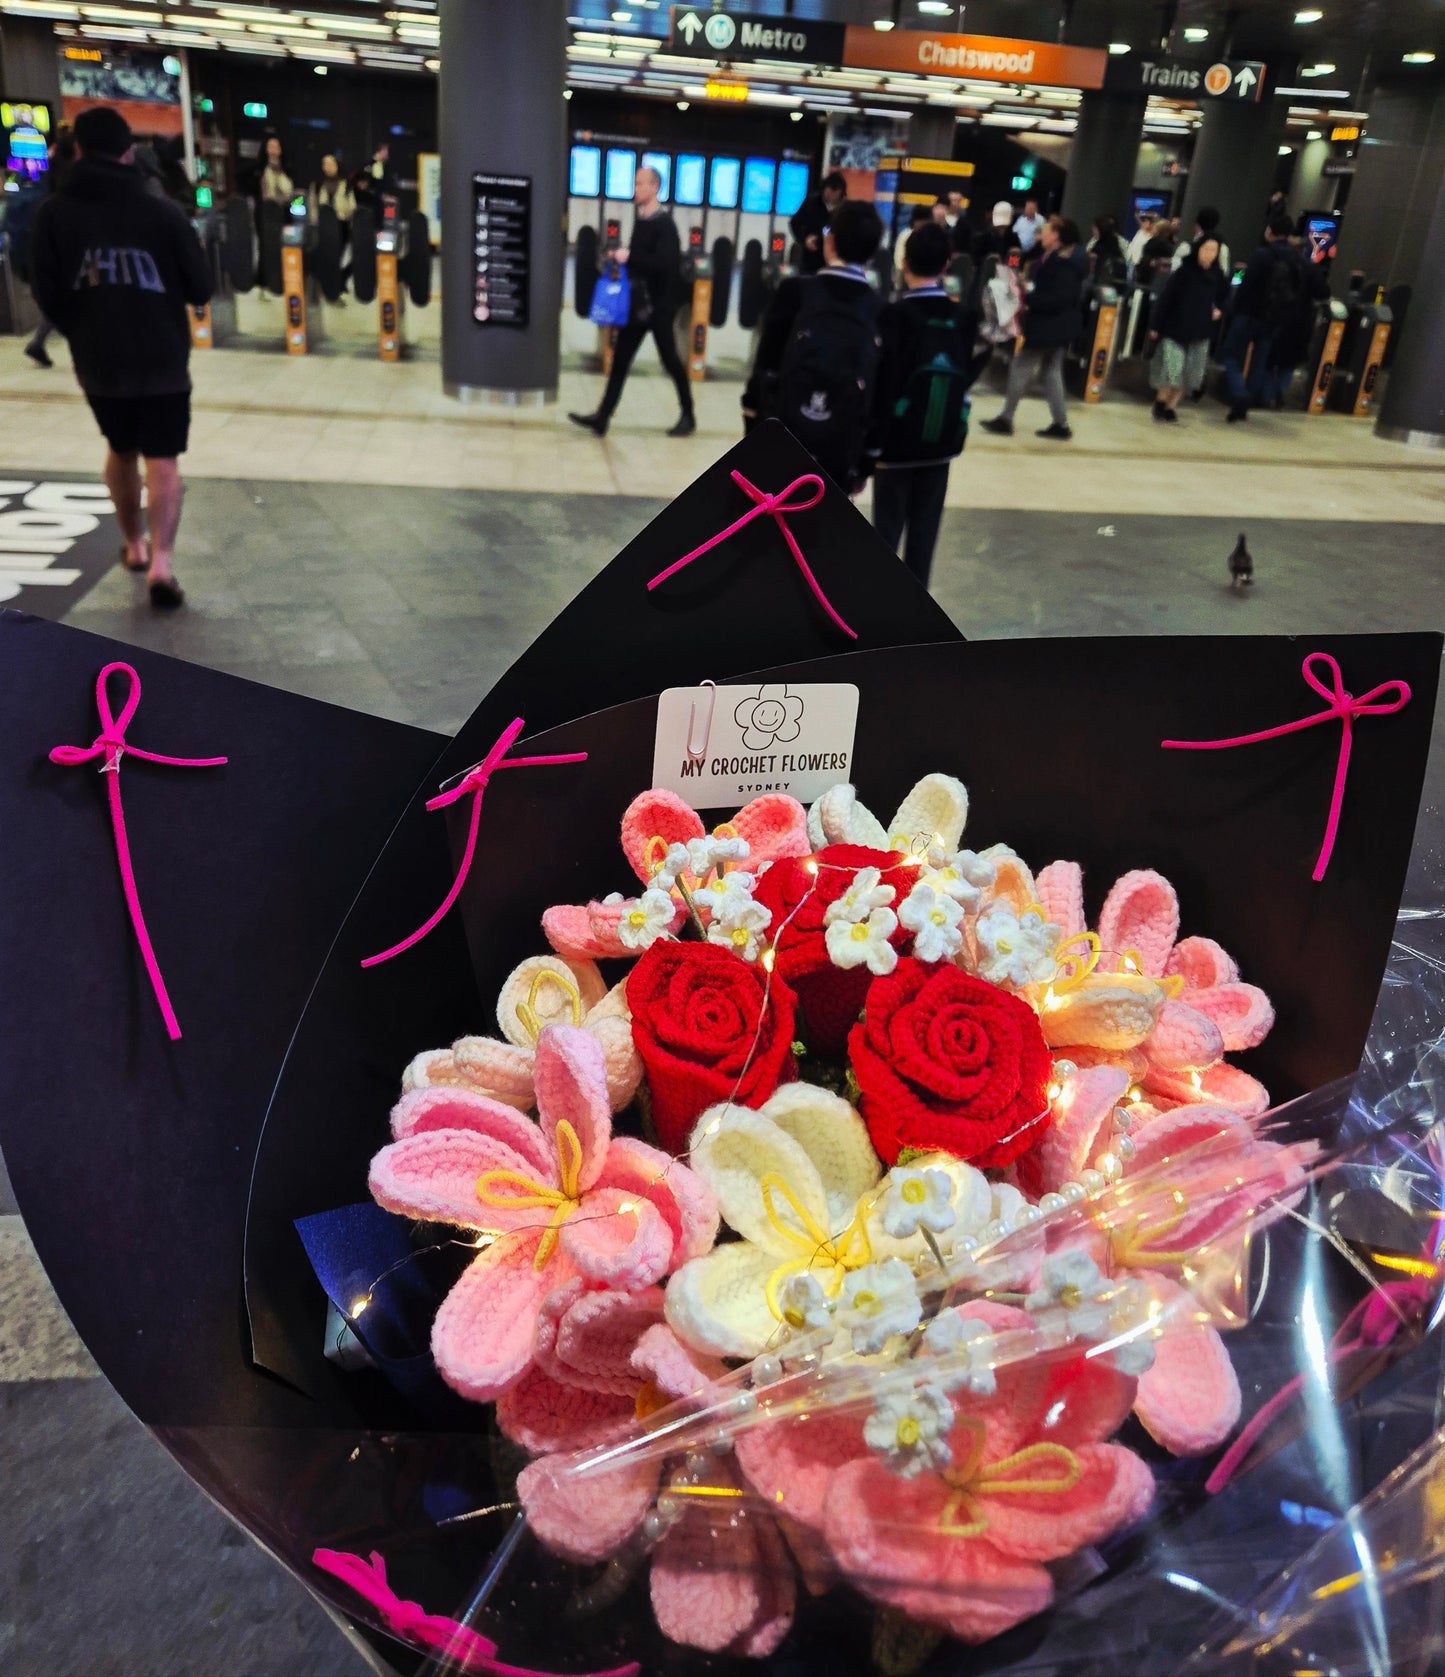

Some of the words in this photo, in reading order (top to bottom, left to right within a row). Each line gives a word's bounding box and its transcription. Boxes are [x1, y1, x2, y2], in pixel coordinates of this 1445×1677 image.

[741, 22, 807, 52] Metro
[918, 40, 1036, 74] Chatswood
[1141, 62, 1201, 89] Trains
[680, 759, 706, 778] MY
[711, 755, 777, 776] CROCHET
[781, 752, 848, 773] FLOWERS
[737, 782, 791, 793] SYDNEY
